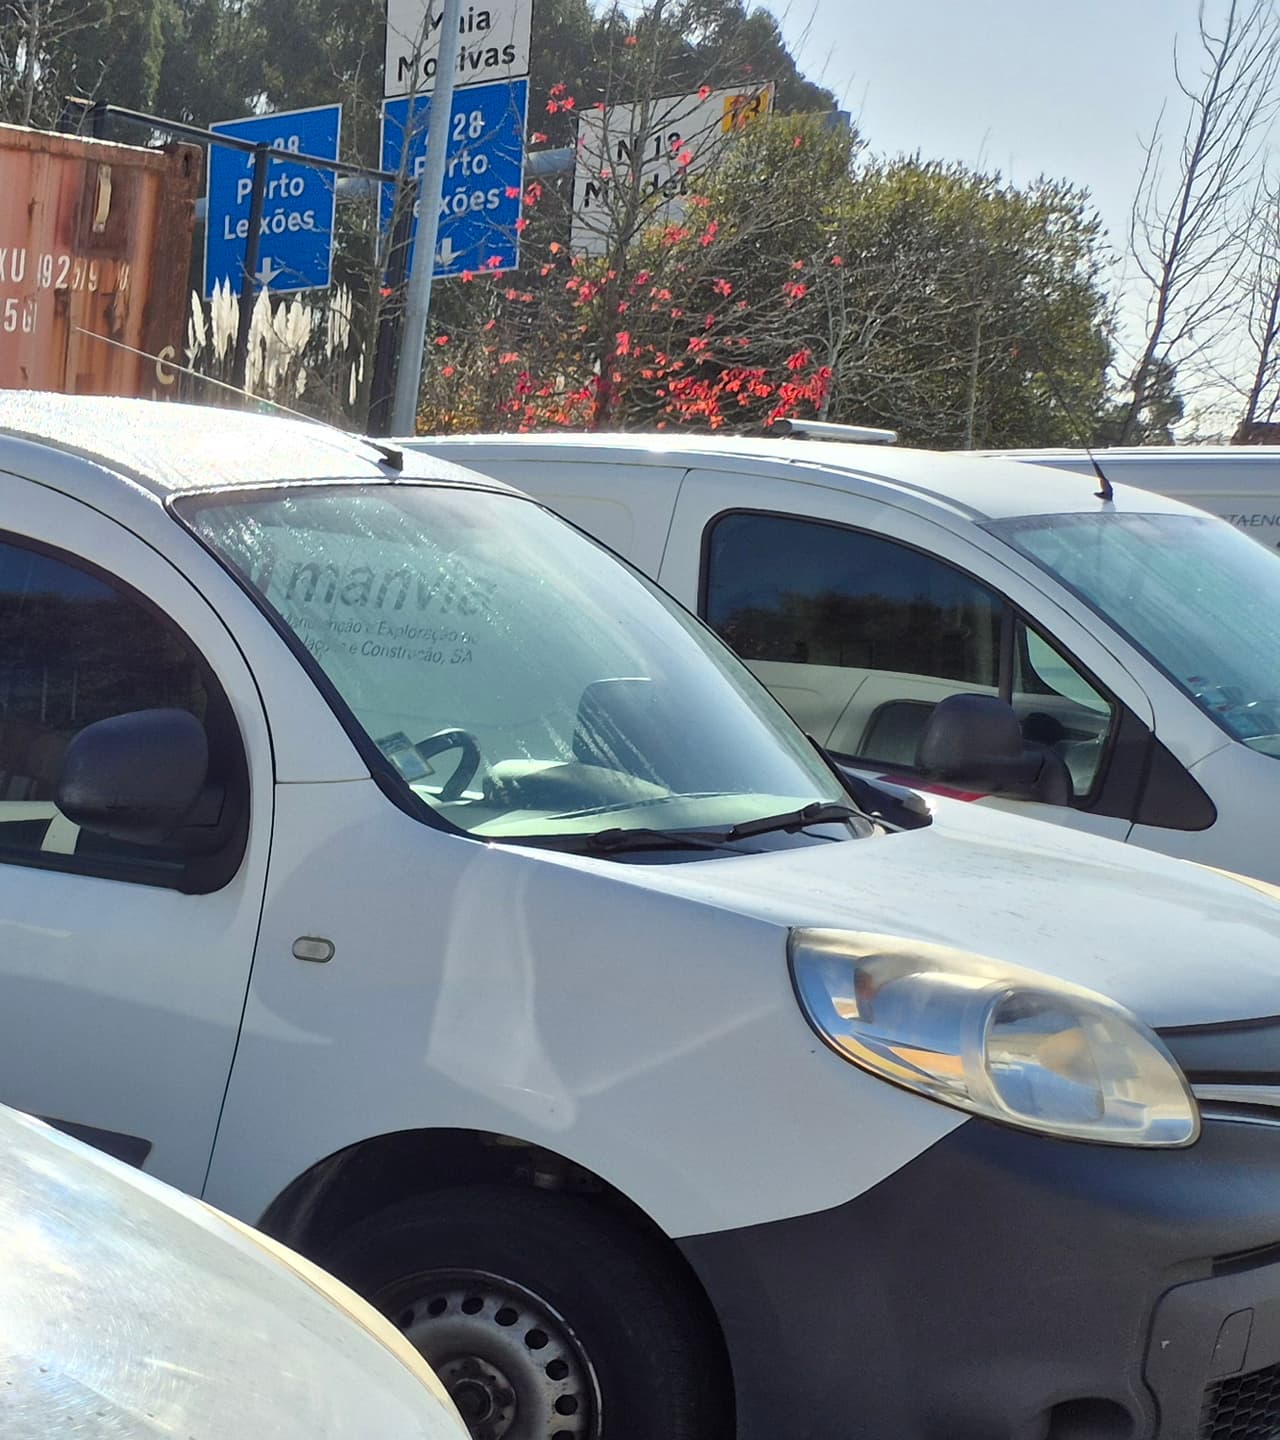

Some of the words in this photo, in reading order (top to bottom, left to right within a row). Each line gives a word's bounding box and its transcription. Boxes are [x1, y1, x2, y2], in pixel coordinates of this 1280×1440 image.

[397, 44, 516, 82] Moivas
[414, 151, 489, 181] Prto
[236, 173, 305, 205] Prto
[224, 208, 315, 240] Lexões
